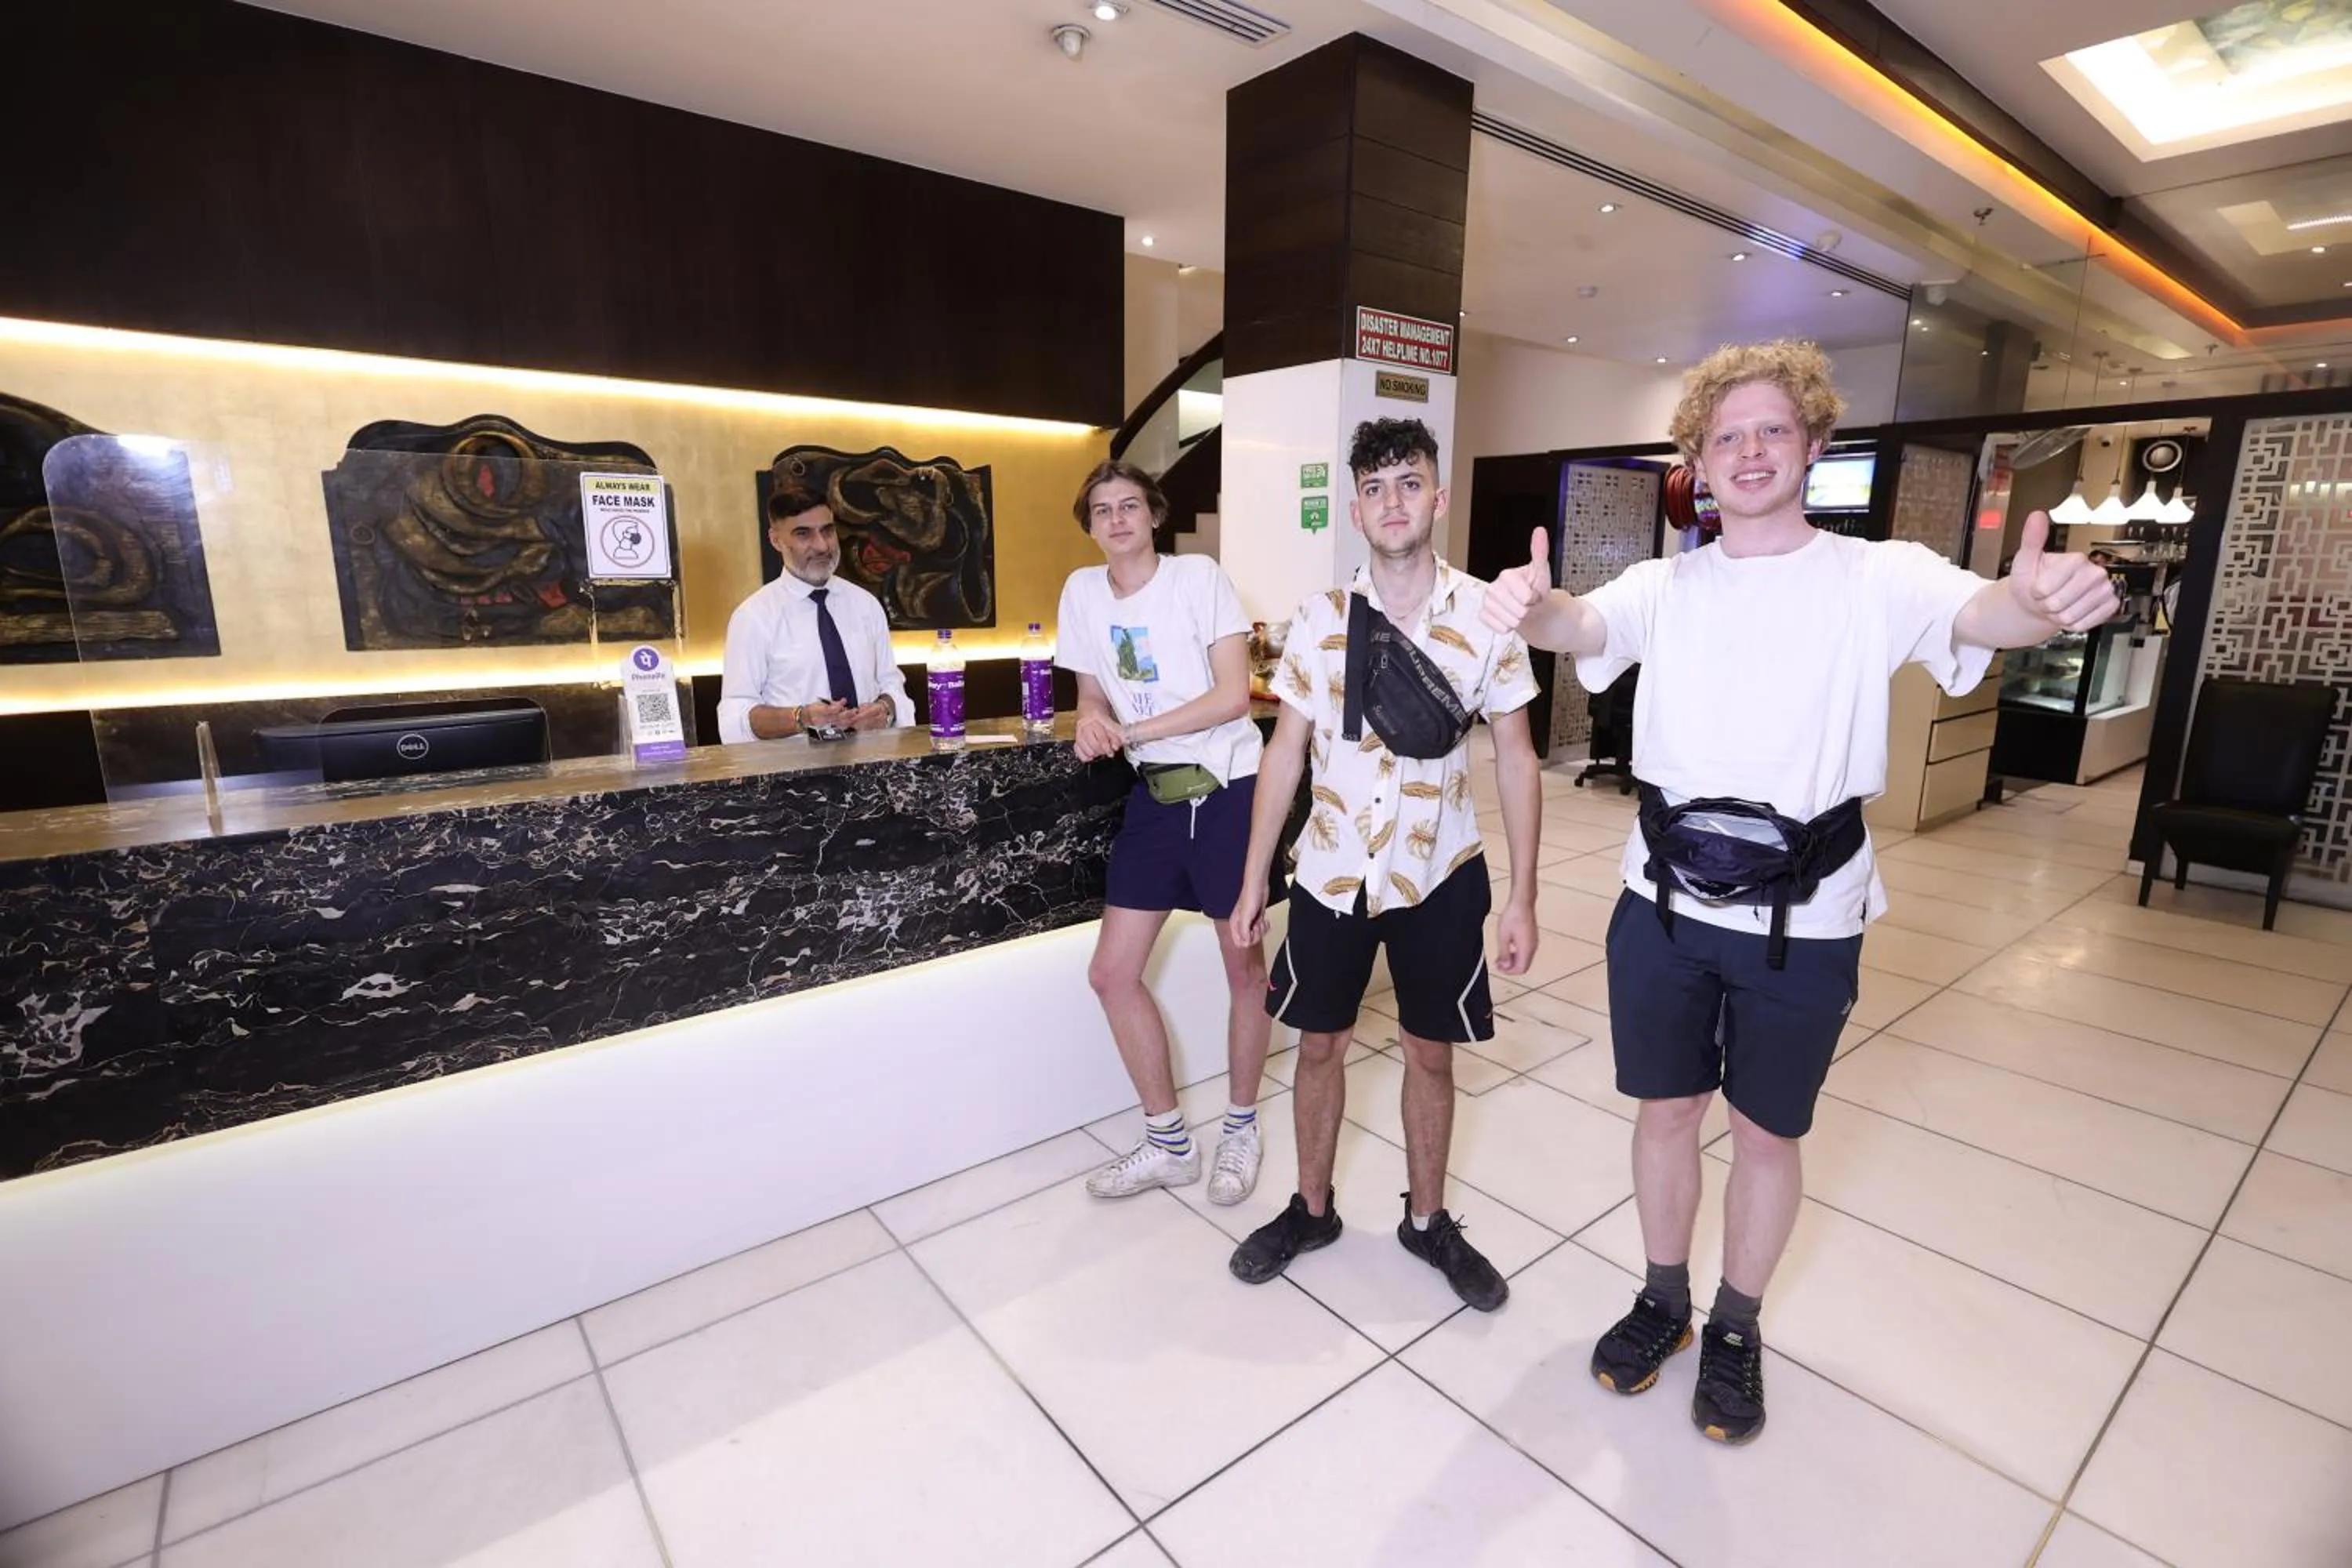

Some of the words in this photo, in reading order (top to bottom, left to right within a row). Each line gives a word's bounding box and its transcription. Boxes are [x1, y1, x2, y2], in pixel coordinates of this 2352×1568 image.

[1360, 313, 1399, 336] DISASTER
[1399, 321, 1450, 347] MANAGEMENT
[1382, 339, 1418, 362] HELPLINE
[1380, 379, 1391, 390] NO
[1392, 380, 1426, 396] SMOKING
[596, 481, 626, 490] ALWAYS
[629, 483, 651, 492] WEAR
[592, 495, 620, 506] FACE
[624, 496, 655, 507] MASK
